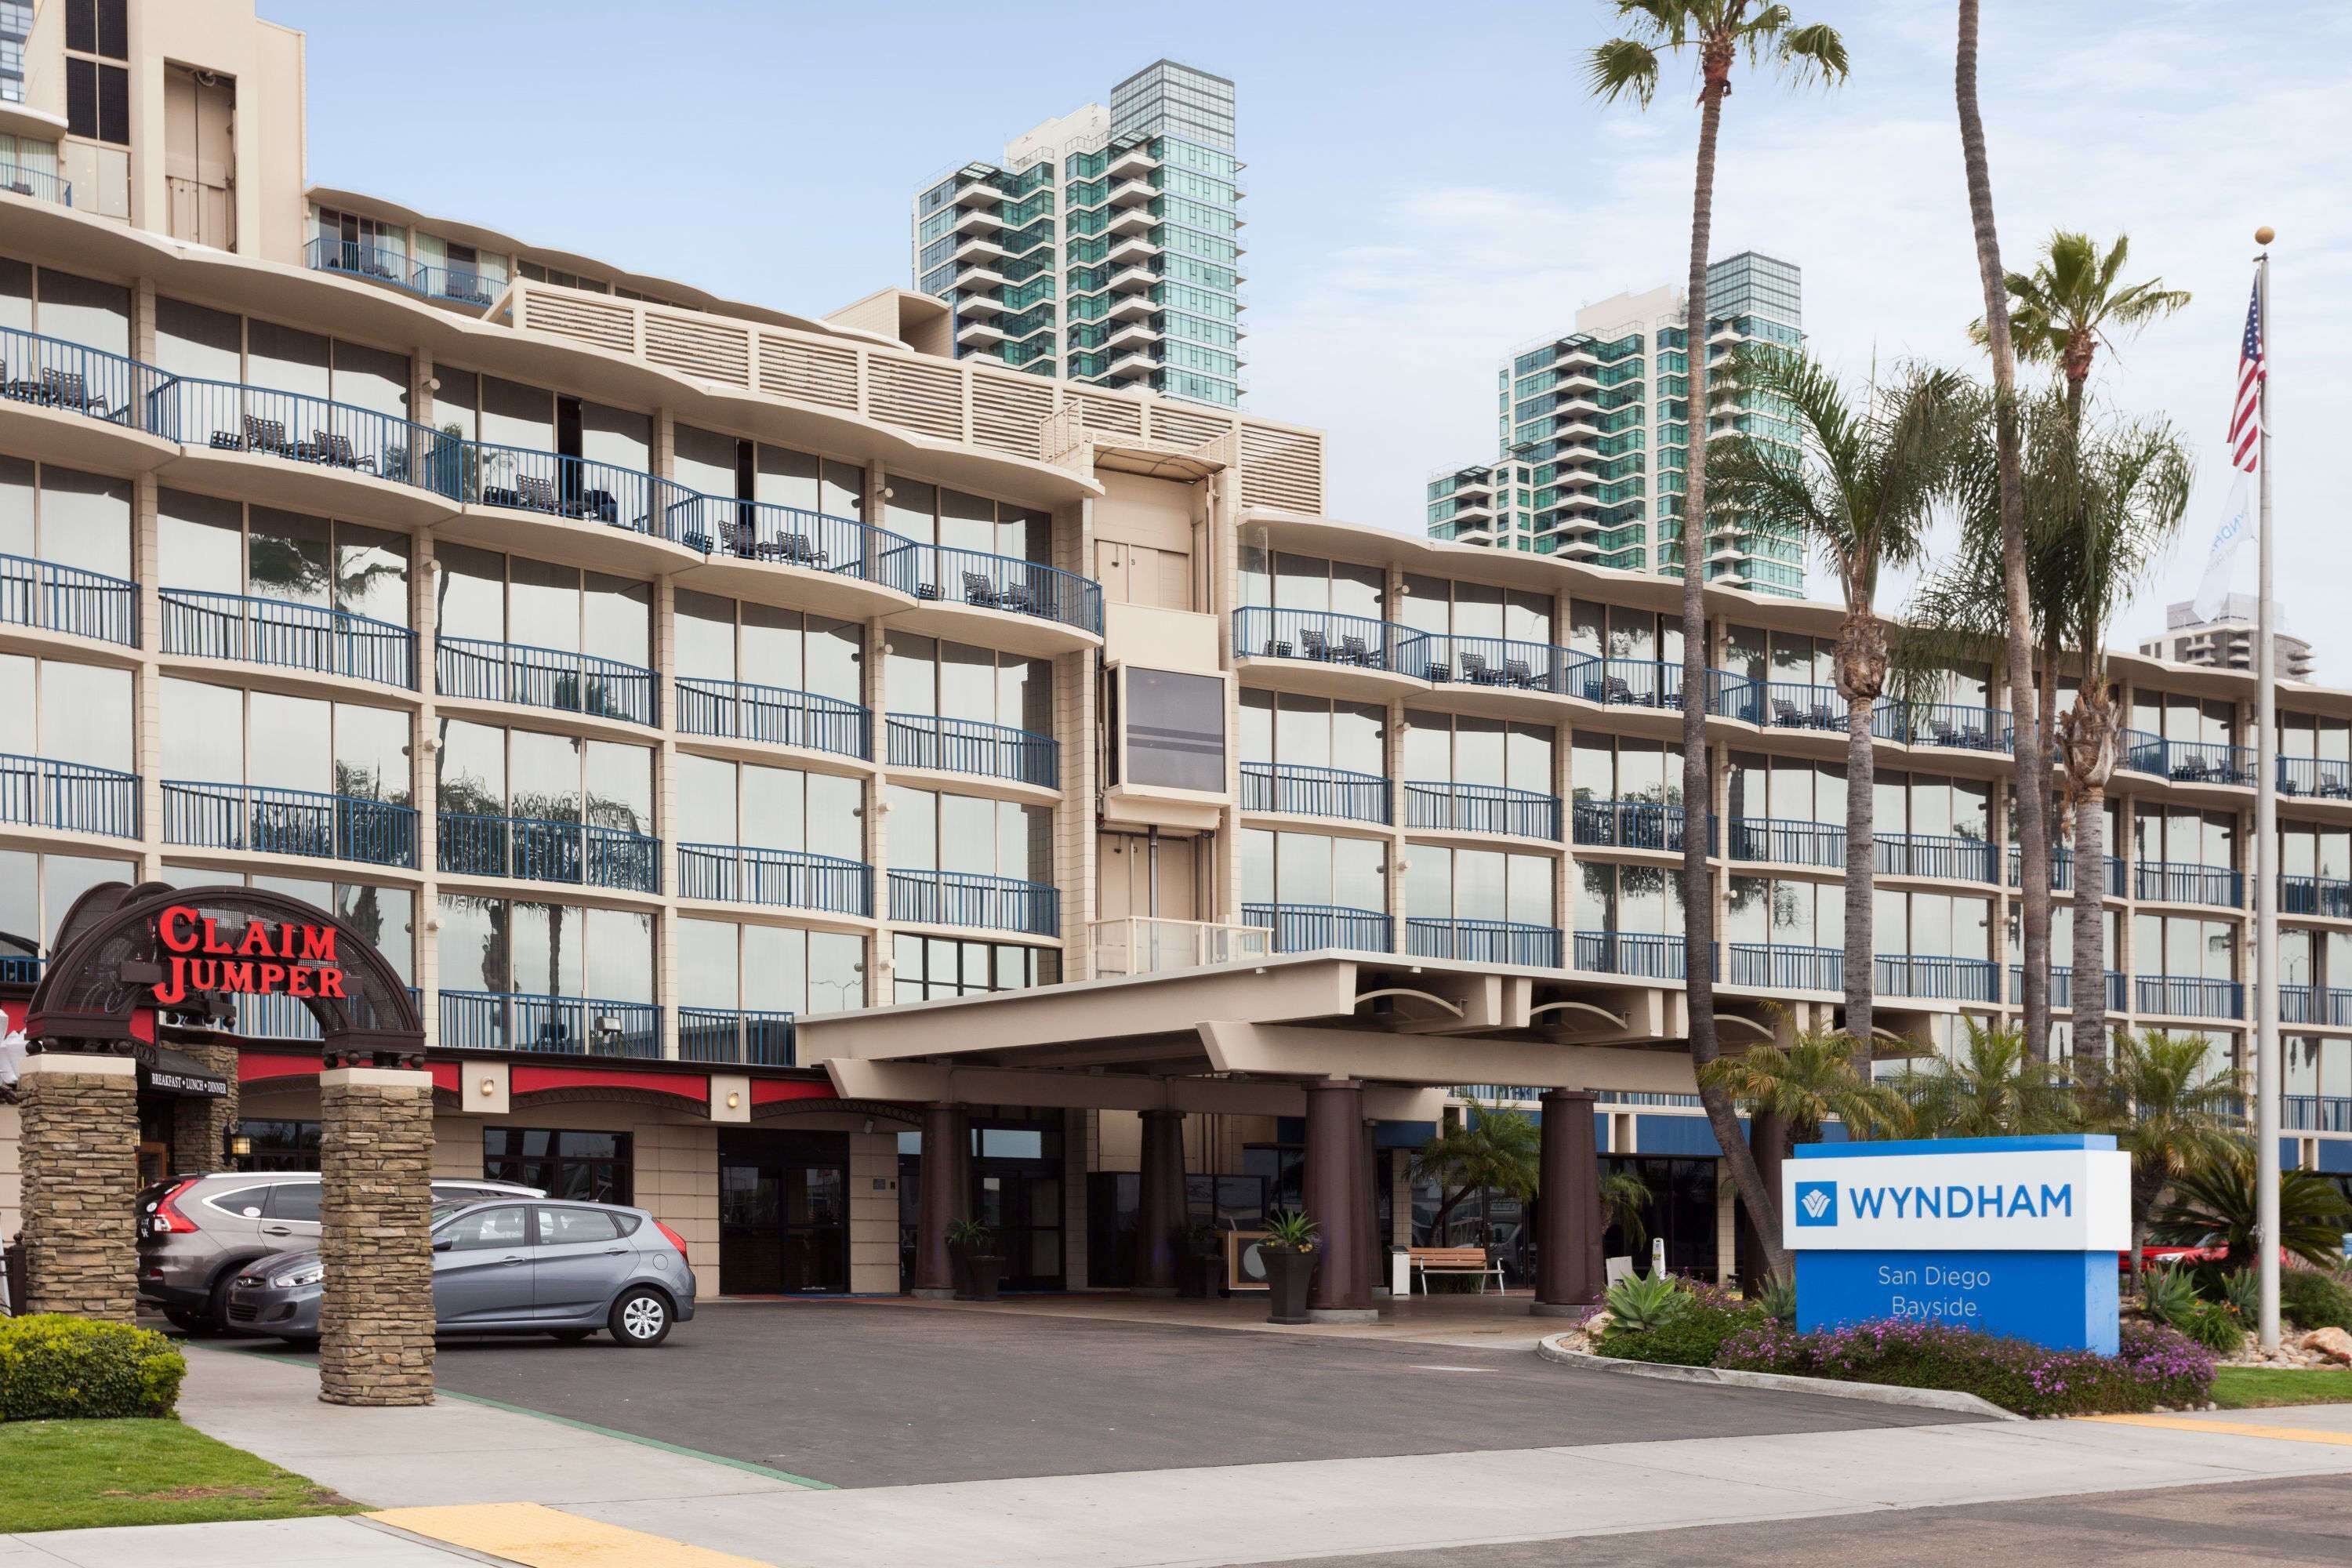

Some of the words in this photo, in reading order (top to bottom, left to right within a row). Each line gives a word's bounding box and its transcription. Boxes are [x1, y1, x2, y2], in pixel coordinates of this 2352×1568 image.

[159, 906, 337, 960] CLAIM
[151, 956, 347, 1004] JUMPER
[151, 1073, 182, 1088] BREAKFAST
[186, 1078, 204, 1091] LUNCH
[208, 1081, 227, 1094] DINNER
[1849, 1184, 2072, 1219] WYNDHAM
[1878, 1265, 1917, 1286] San
[1926, 1266, 1991, 1290] Diego
[1892, 1296, 1977, 1317] Bayside
